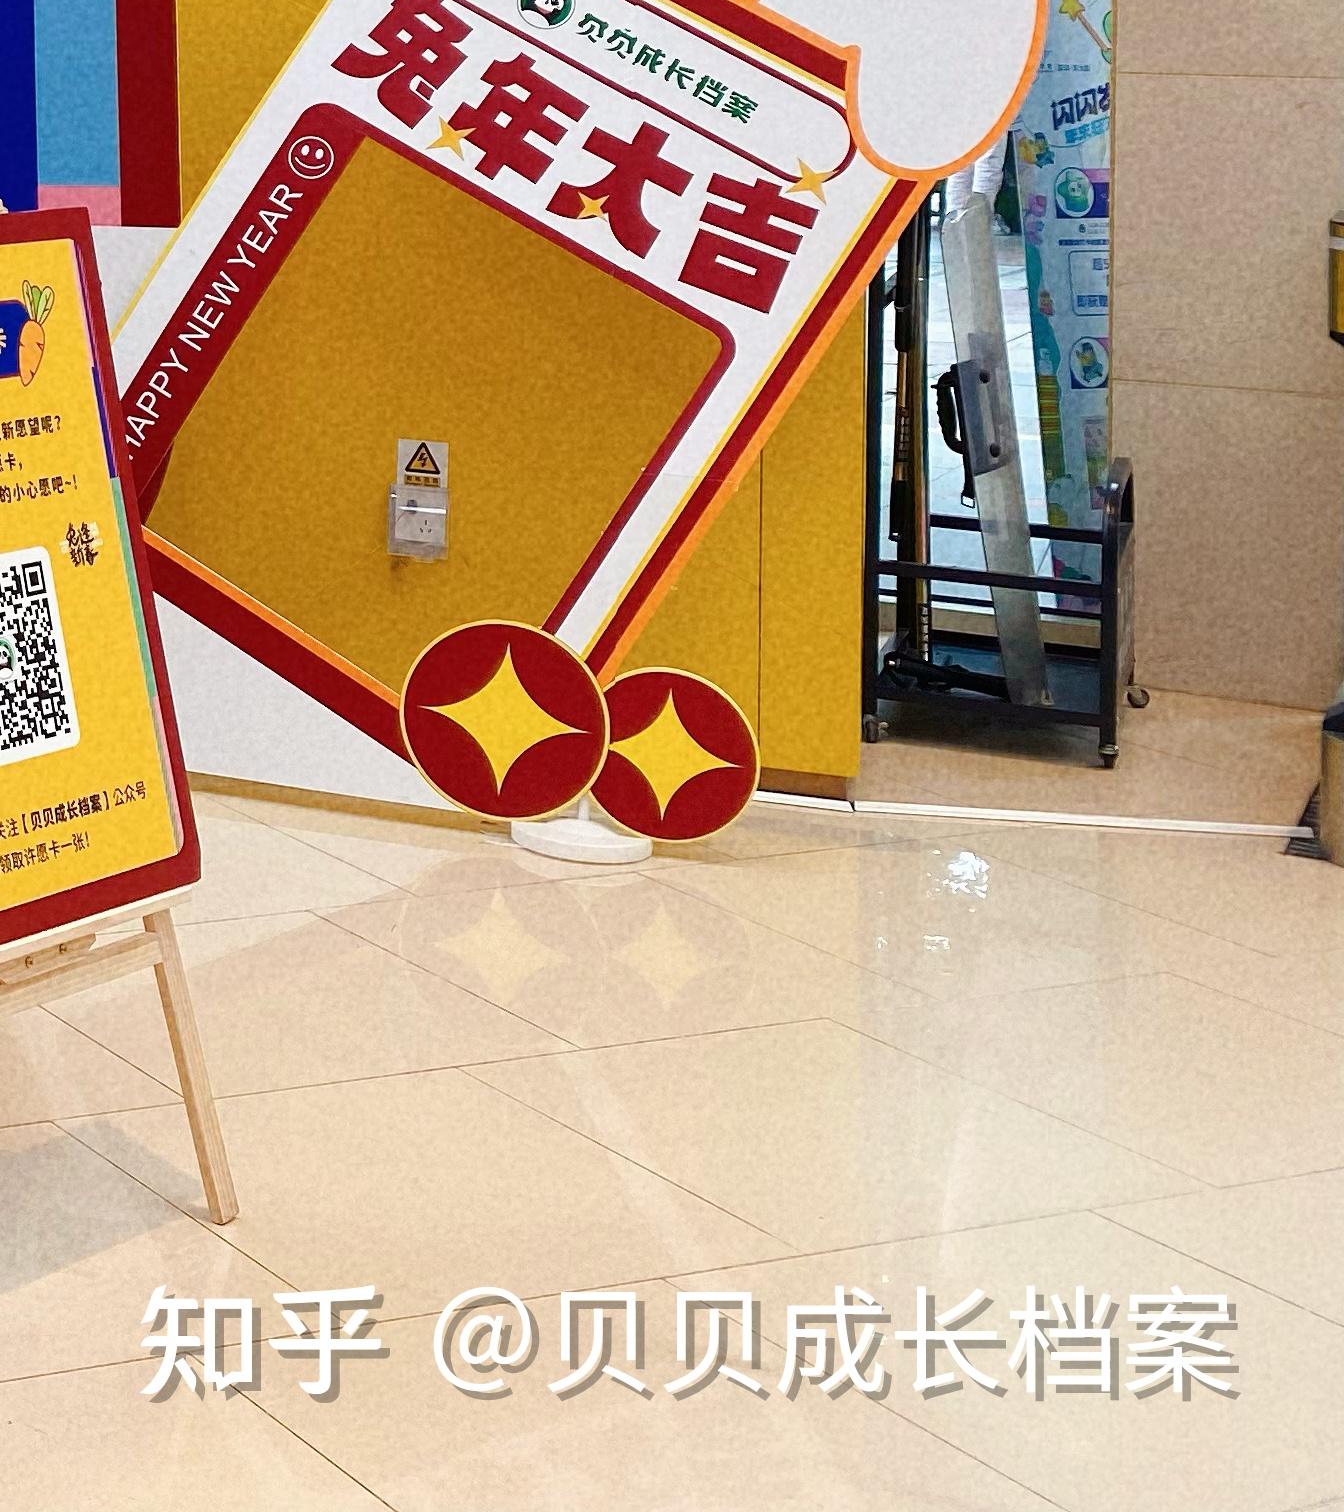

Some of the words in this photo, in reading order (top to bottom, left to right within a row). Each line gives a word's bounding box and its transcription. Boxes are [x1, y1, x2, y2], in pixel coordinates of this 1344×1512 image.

[575, 12, 758, 125] 贝贝成长档案
[178, 270, 240, 351] NEW
[227, 184, 303, 269] YEAR
